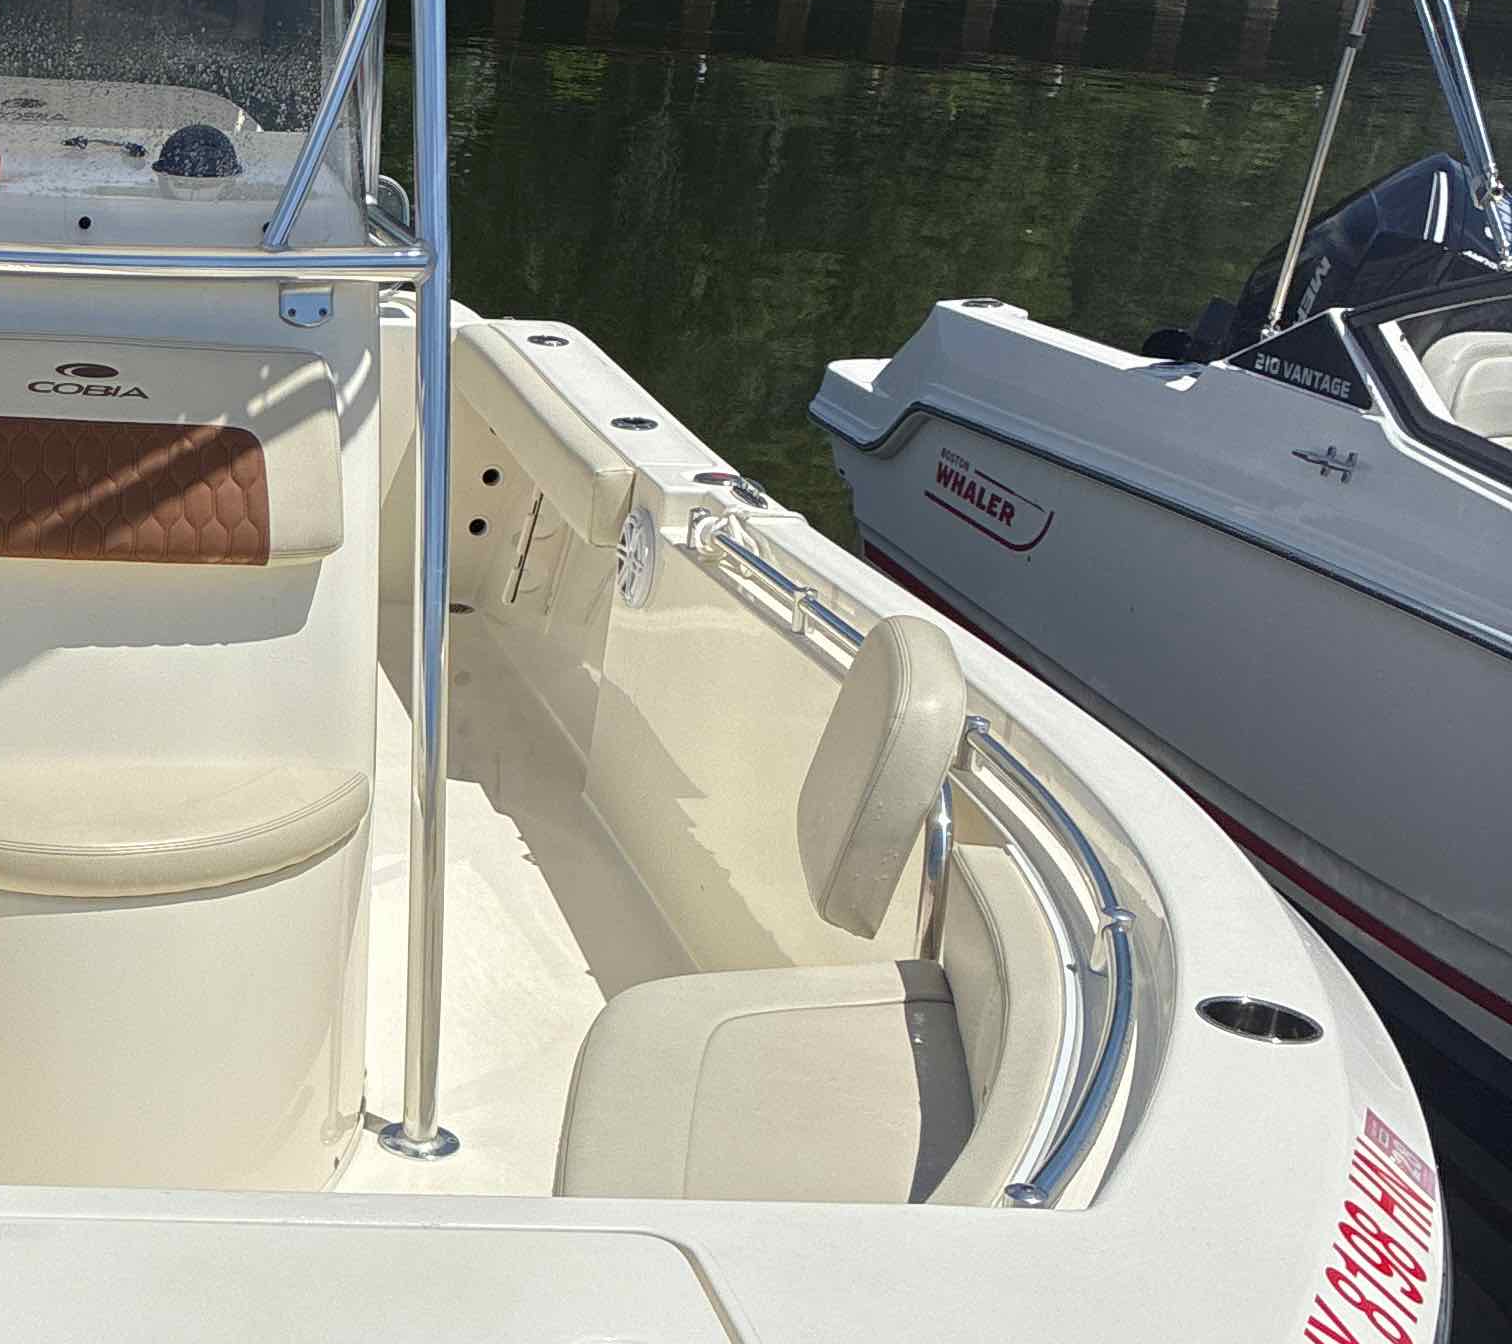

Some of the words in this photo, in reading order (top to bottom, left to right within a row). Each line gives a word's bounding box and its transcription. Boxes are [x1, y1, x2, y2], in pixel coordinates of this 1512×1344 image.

[27, 380, 150, 400] COBIA
[1254, 352, 1281, 373] 210
[1282, 360, 1351, 399] VANTAGE
[935, 459, 1016, 528] WHALER
[1348, 1136, 1434, 1253] HN
